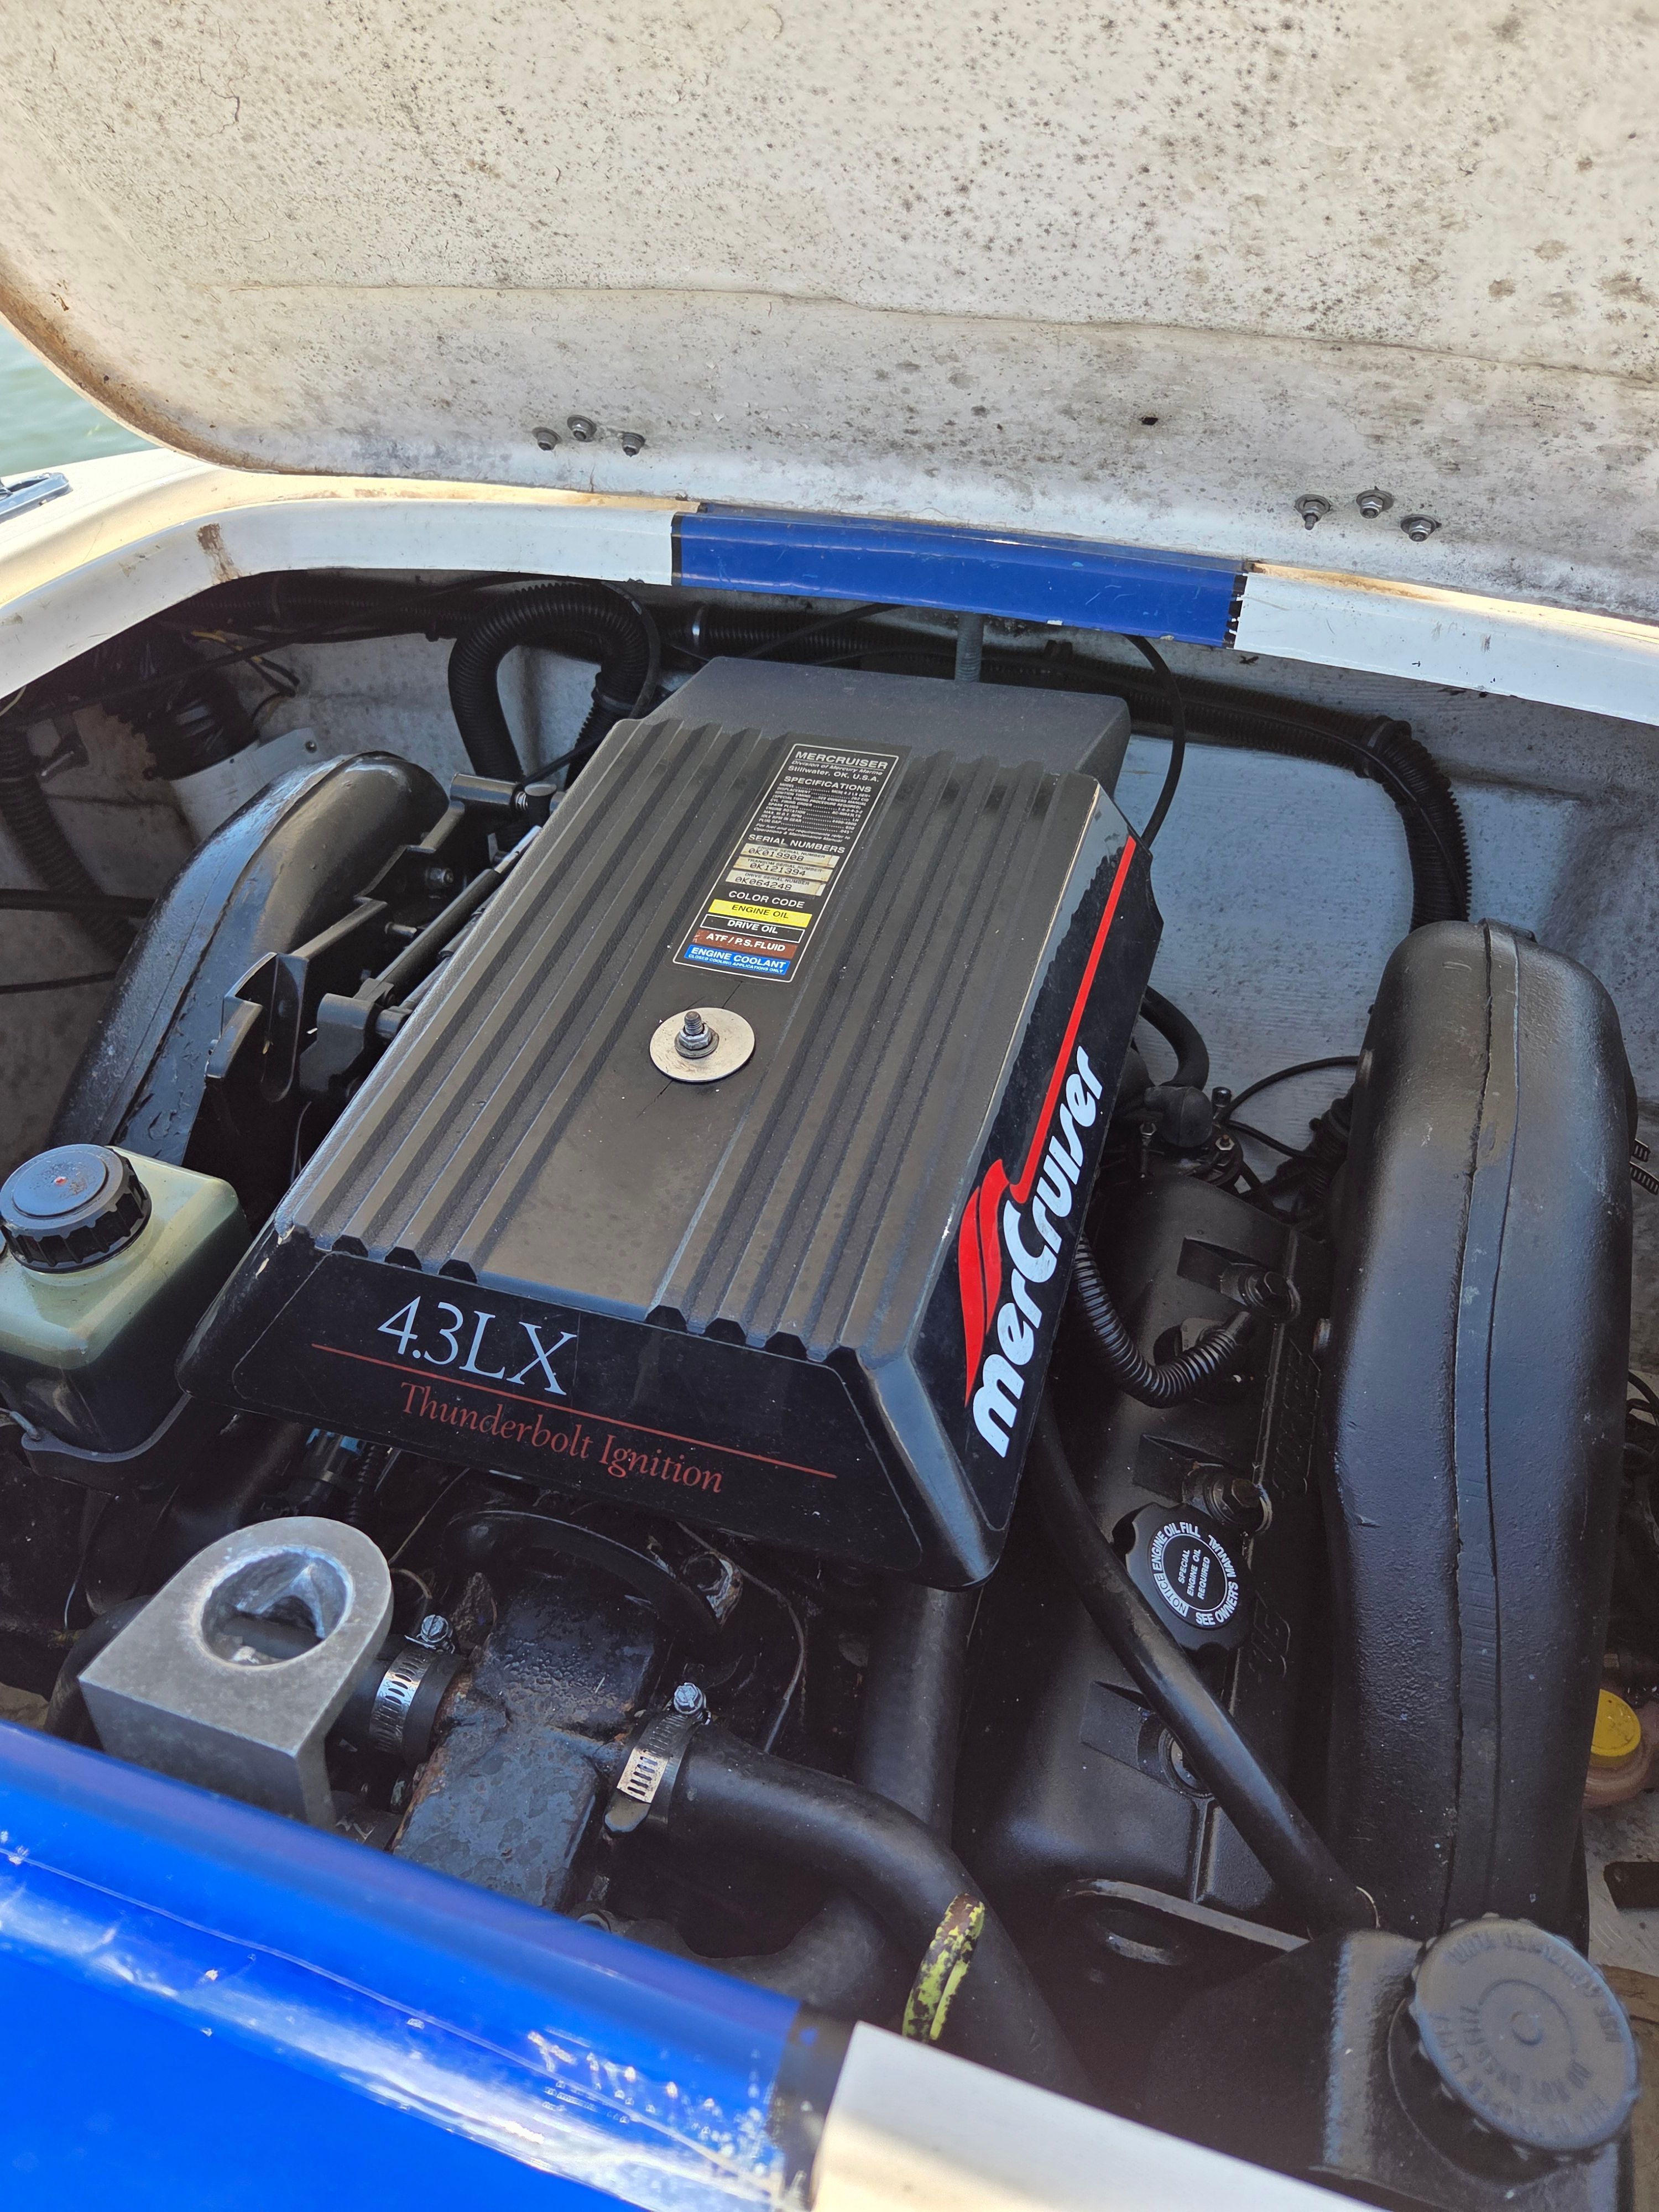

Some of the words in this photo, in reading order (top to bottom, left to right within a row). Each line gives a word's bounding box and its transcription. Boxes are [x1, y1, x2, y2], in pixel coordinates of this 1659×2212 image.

[795, 751, 888, 770] MERCRUISER
[830, 764, 858, 773] Mercury
[788, 765, 831, 776] Stillwater,
[853, 774, 879, 782] U.S.A.
[784, 776, 872, 792] SPECIFICATIONS
[748, 834, 785, 844] SERIAL
[790, 839, 846, 853] NUMBERS
[729, 890, 769, 903] COLOR
[771, 898, 805, 909] CODE
[732, 904, 771, 916] ENGINE
[773, 910, 789, 919] OIL
[727, 920, 760, 931] DRIVE
[761, 925, 779, 934] OIL
[706, 932, 727, 942] ATF
[734, 938, 753, 947] P.S.
[754, 941, 786, 952] FLUID
[691, 947, 732, 960] ENGINE
[733, 954, 787, 969] COOLANT
[732, 962, 769, 972] APPLICATIONS
[400, 1381, 593, 1459] Thunderbolt
[599, 1434, 723, 1493] Ignition
[1164, 1522, 1181, 1537] OIL
[1180, 1521, 1201, 1538] FILL
[1151, 1531, 1168, 1571] ENGINE
[1208, 1534, 1237, 1578] MANUAL
[1177, 1549, 1190, 1584] SPECIAL
[1186, 1564, 1198, 1597] ENGINE
[1192, 1548, 1202, 1562] OIL
[1197, 1556, 1211, 1600] REQUIRED
[1155, 1573, 1188, 1616] NOTICE
[1214, 1581, 1239, 1623] OWNER'S
[1195, 1612, 1216, 1626] SEE
